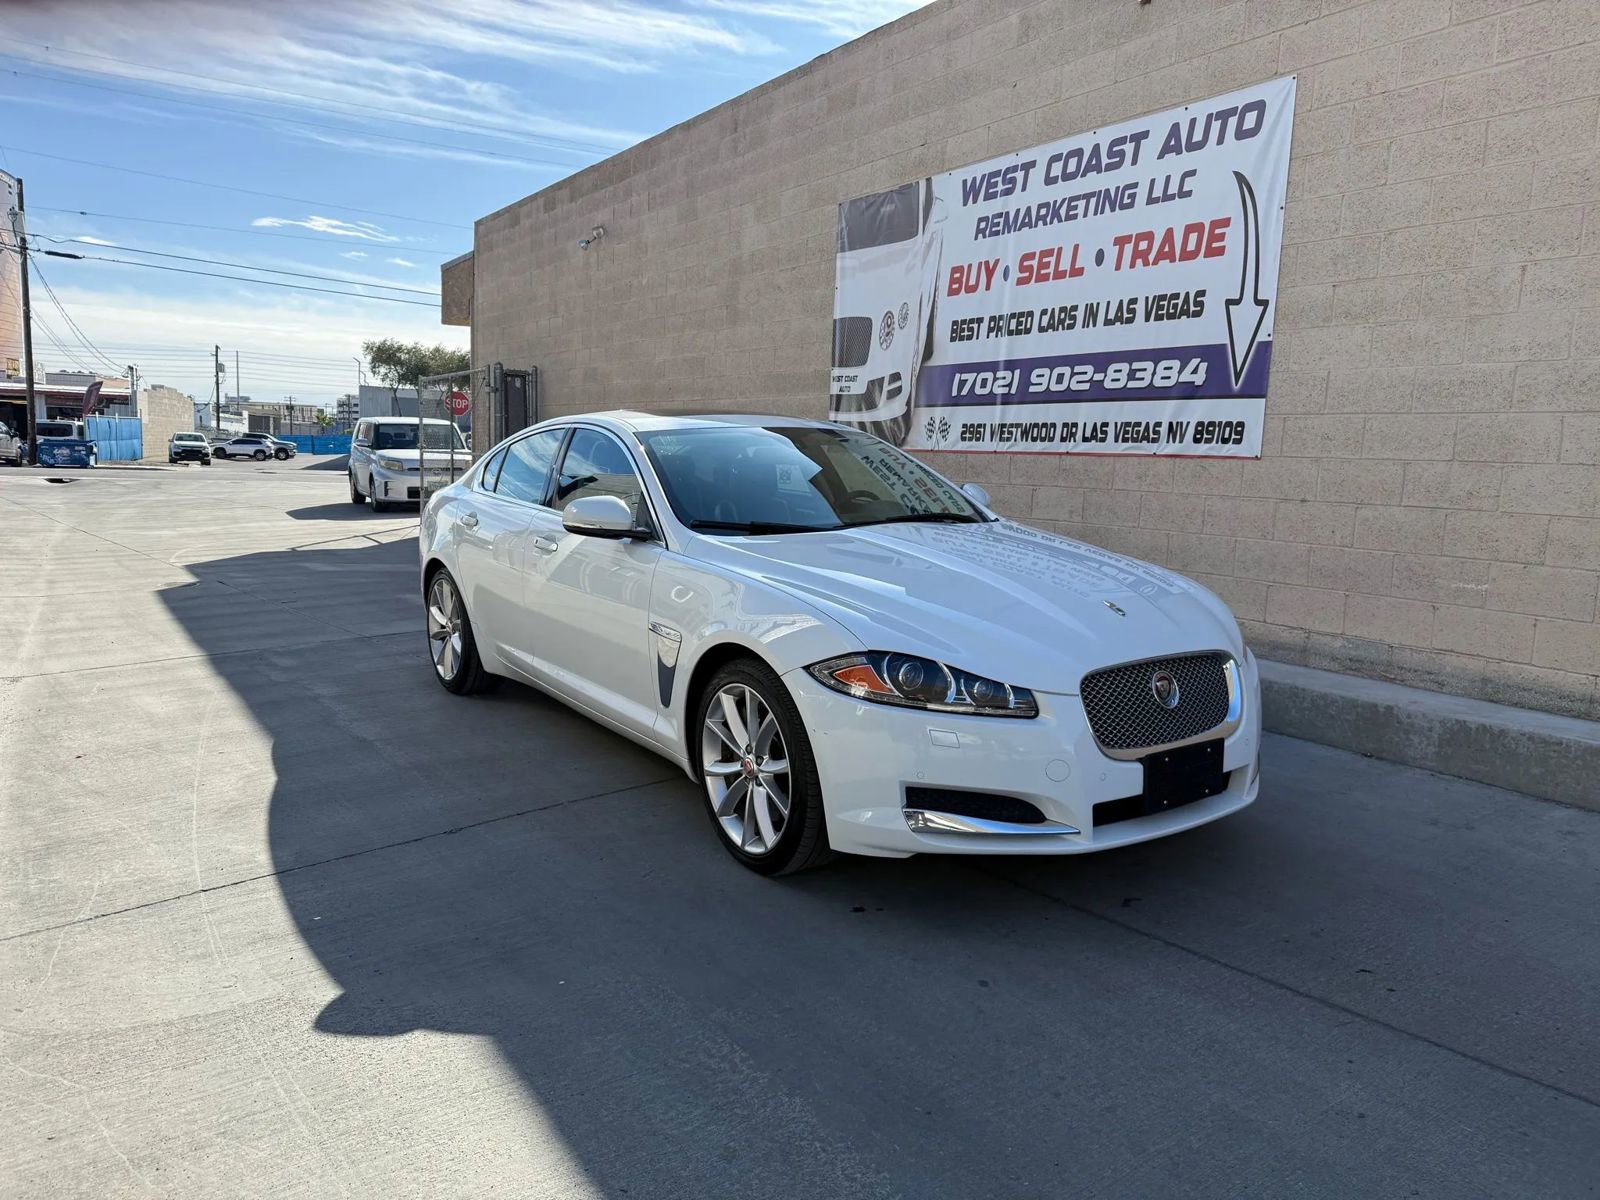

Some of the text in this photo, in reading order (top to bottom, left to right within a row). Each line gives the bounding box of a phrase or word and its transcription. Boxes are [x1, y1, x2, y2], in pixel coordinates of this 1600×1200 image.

[962, 99, 1267, 207] WEST COAST AUTO
[974, 169, 1197, 241] REMARKETING LLC
[947, 216, 1232, 297] BUY SELL TRADE
[949, 289, 1207, 343] BEST PRICED CARS IN LAS VEGAS
[446, 399, 468, 409] STOP
[951, 357, 1209, 397] (702) 902-8384
[960, 420, 1246, 445] 2961 WESTWOOD DR LAS VEGAS NV 89109
